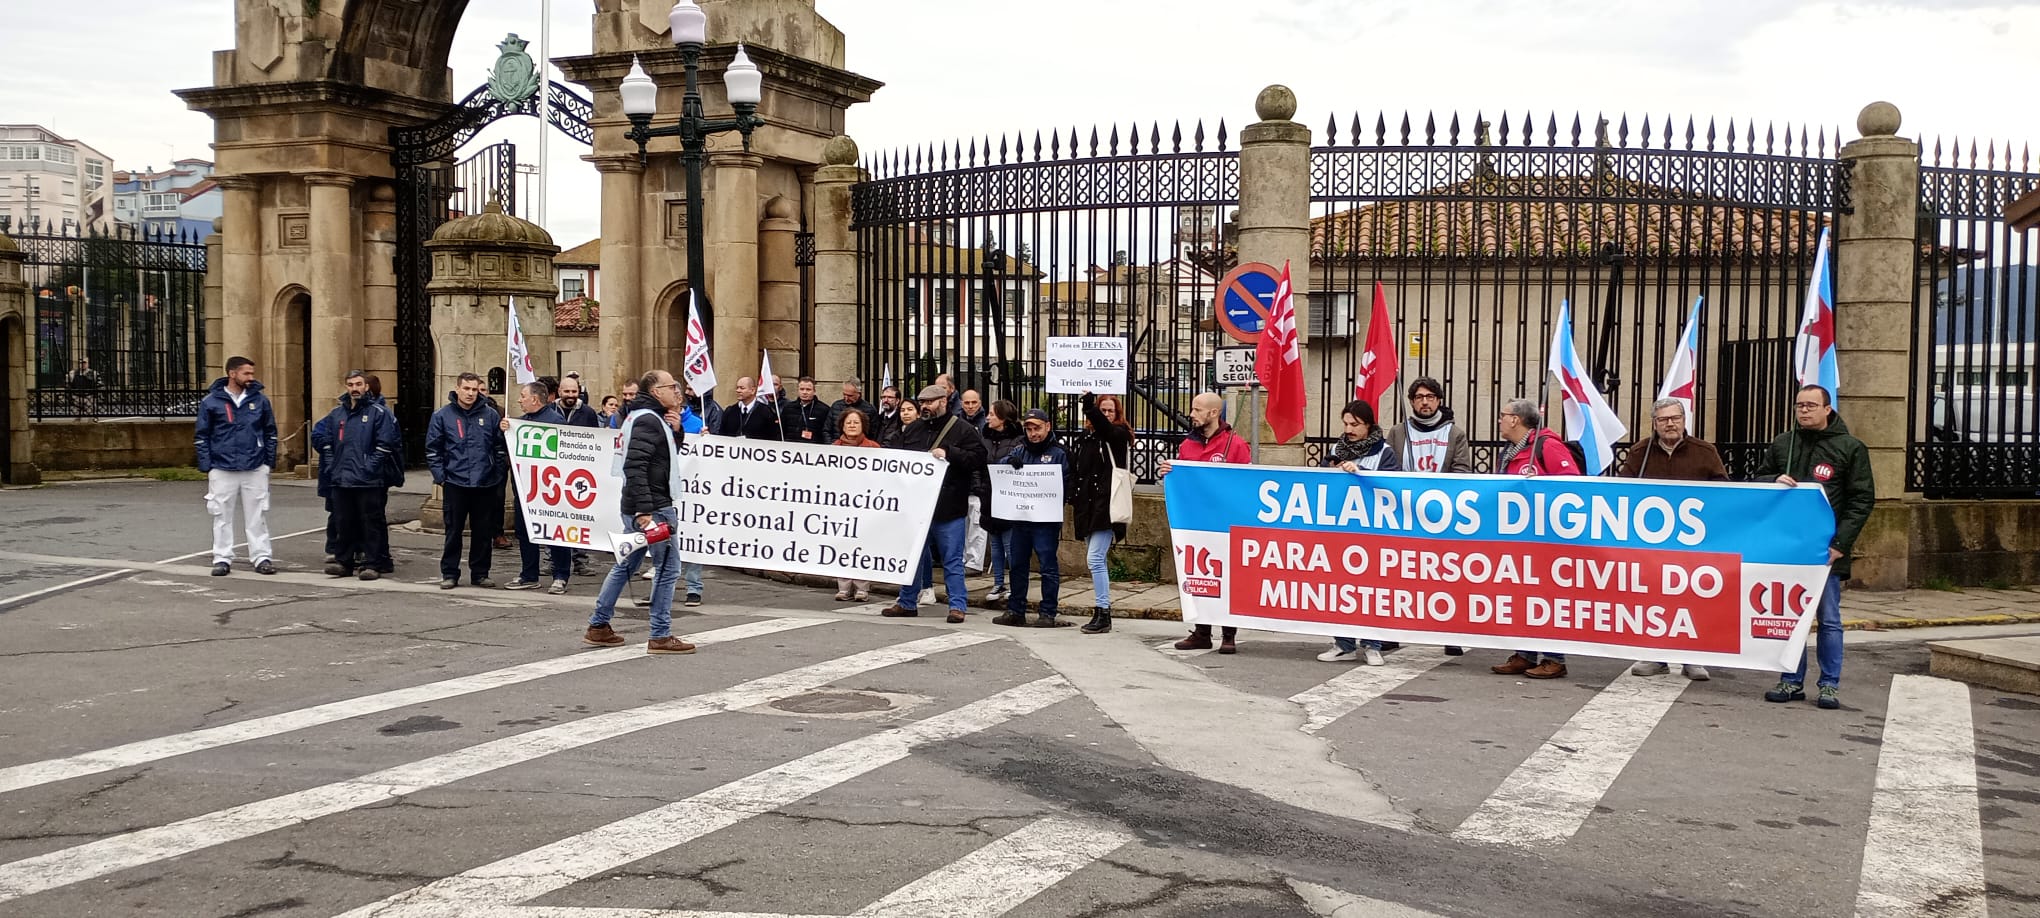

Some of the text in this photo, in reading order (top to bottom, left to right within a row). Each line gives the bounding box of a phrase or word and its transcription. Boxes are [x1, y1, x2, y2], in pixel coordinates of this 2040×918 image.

[1081, 341, 1122, 349] DEFENSA
[1050, 358, 1125, 369] Sueldo 1,062 €
[1229, 364, 1255, 372] ZON
[1060, 379, 1092, 387] Trienios
[559, 429, 595, 440] Federación
[559, 440, 588, 451] Atención
[594, 442, 602, 452] la
[559, 451, 595, 462] Ciudadanía
[702, 444, 725, 458] DE
[729, 446, 777, 462] UNOS
[781, 450, 868, 471] SALARIOS
[872, 458, 935, 476] DIGNOS
[721, 476, 900, 512] discriminación
[1007, 491, 1057, 499] MANTENIMIENTO
[538, 509, 569, 519] SINDICAL
[570, 513, 595, 522] OBRERA
[1257, 480, 1706, 546] SALARIOS DIGNOS
[692, 503, 794, 532] Personal
[803, 513, 859, 539] Civil
[782, 541, 810, 563] de
[818, 544, 908, 574] Defensa
[1176, 545, 1223, 578] IG
[1242, 539, 1723, 599] PARA O PERSOAL CIVIL DO
[1259, 578, 1698, 639] MINISTERIO DE DEFENSA
[1752, 619, 1797, 628] AMINISTRA
[1767, 627, 1792, 637] PÚBLI
